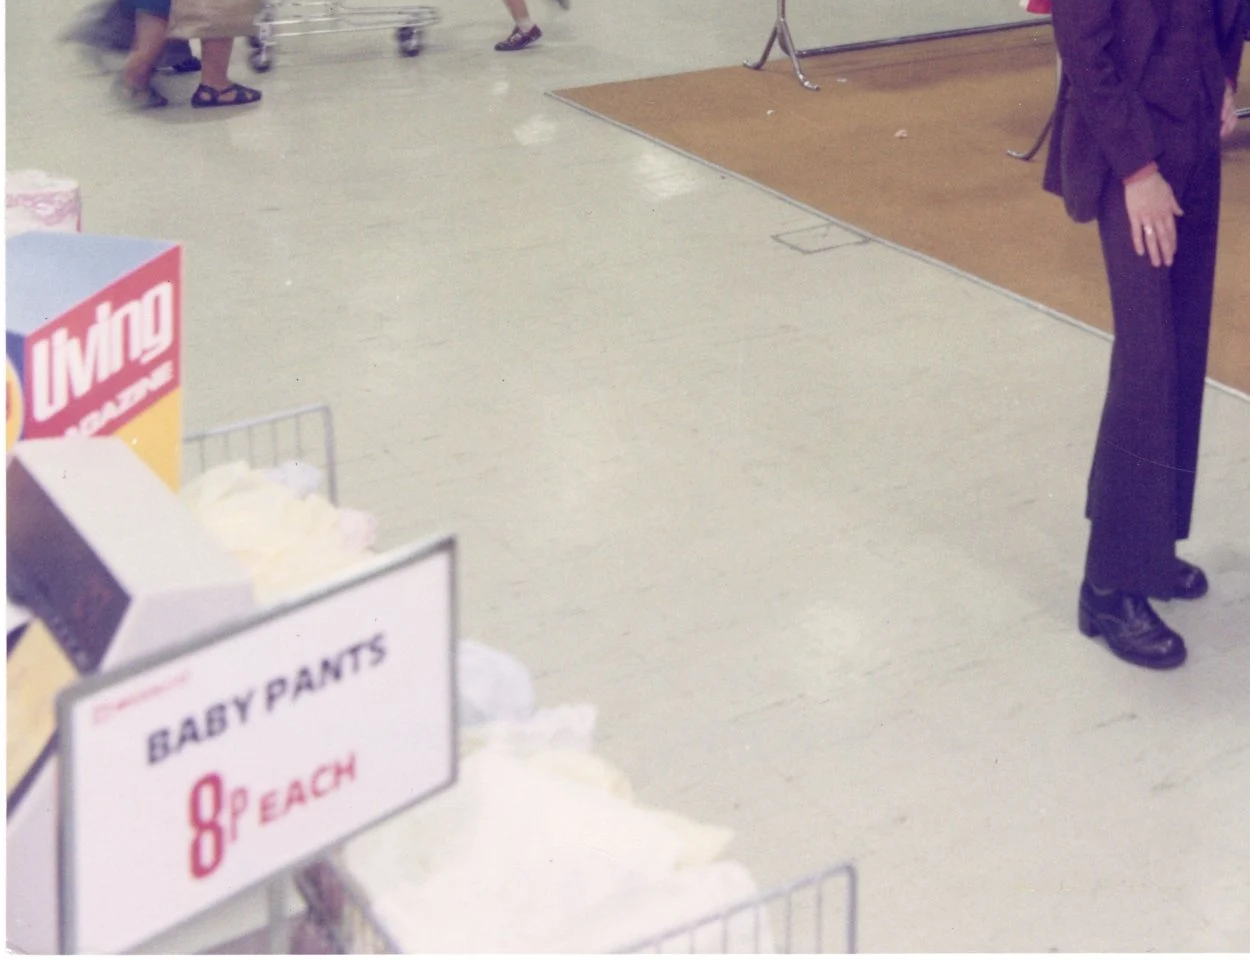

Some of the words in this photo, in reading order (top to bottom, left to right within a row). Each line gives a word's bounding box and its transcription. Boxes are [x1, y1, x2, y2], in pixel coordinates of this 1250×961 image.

[64, 360, 174, 440] AGAZINE
[147, 689, 255, 766] BABY
[265, 633, 387, 713] PANTS
[258, 752, 358, 827] EACH
